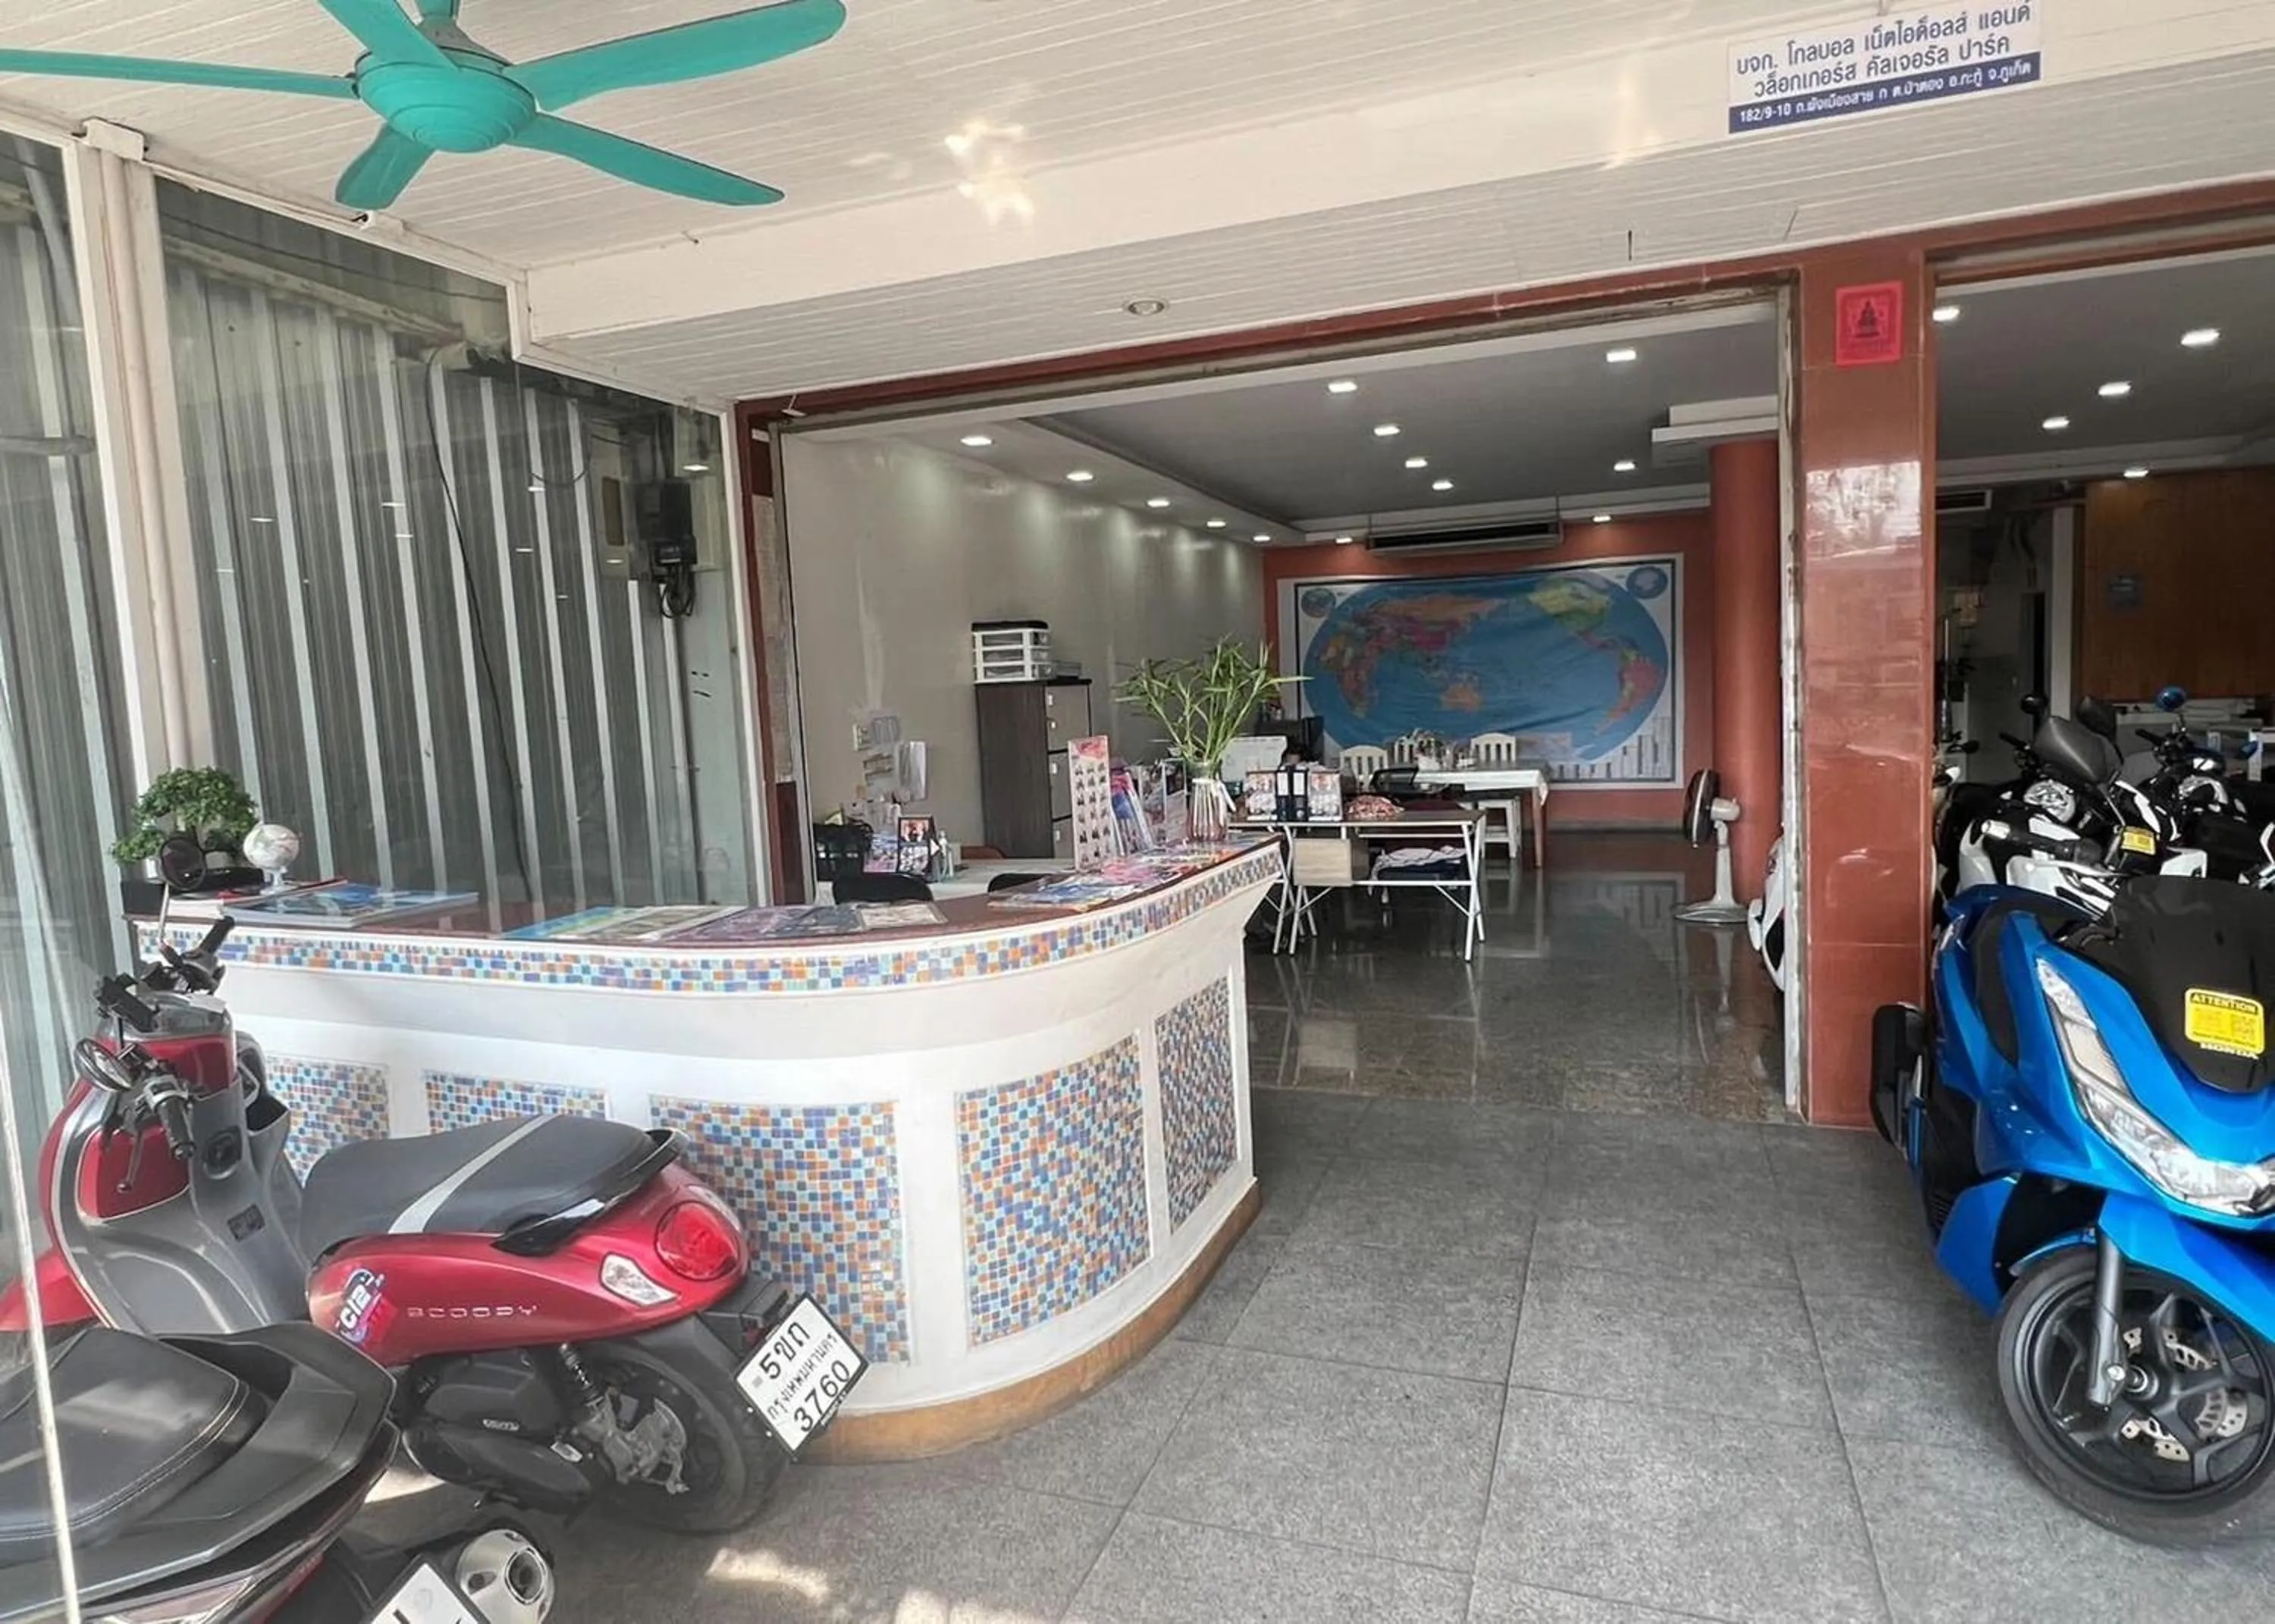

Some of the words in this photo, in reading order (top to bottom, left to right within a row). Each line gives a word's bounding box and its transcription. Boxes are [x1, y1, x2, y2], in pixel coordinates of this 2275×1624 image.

[1737, 54, 1778, 75] บจก.
[1787, 38, 1855, 66] โกลบอล
[1864, 11, 1967, 52] เน็ตไอด็อลส์
[1754, 61, 1857, 98] วล็อกเกอร์ส
[1959, 33, 2010, 61] ปาร์ค
[1740, 102, 1790, 123] 182/9-10
[2192, 994, 2256, 1013] ATTENTION
[793, 1360, 850, 1432] 3760
